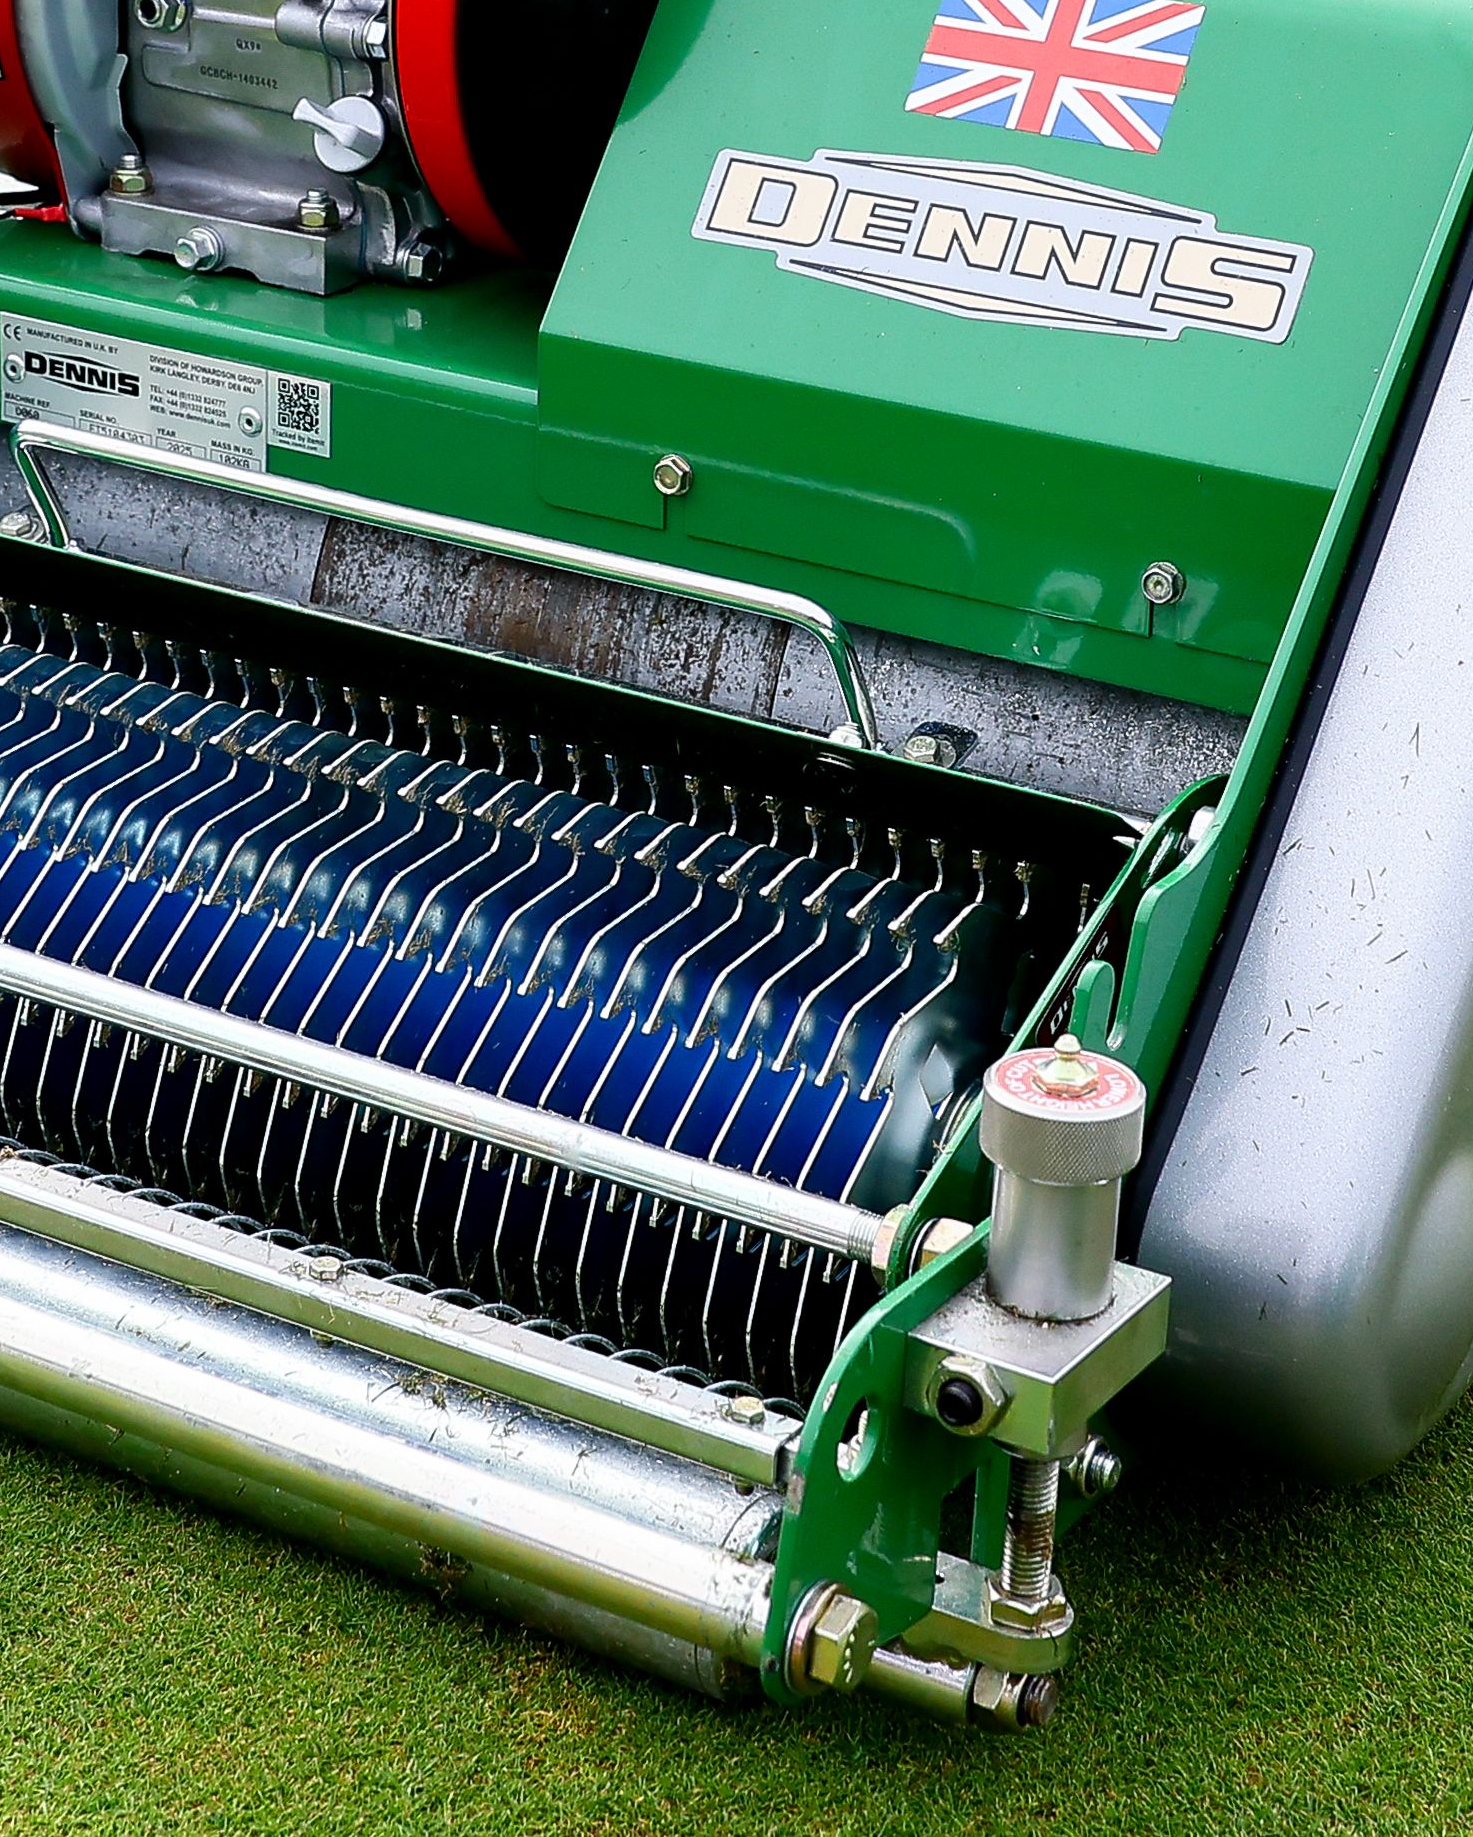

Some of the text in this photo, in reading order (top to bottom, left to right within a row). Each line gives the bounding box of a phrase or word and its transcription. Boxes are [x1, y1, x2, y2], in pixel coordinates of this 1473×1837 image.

[706, 158, 1298, 332] DENNIS
[27, 328, 83, 347] MANUFACTURED
[84, 341, 92, 349] IN
[108, 345, 119, 355] BY
[24, 351, 140, 397] DENNIS
[149, 354, 179, 368] DIVISION
[180, 361, 190, 370] OF
[191, 365, 236, 381] HOWARDSON
[149, 365, 166, 375] KIRK
[4, 392, 36, 406] MACHINE
[149, 384, 164, 394] TEL:
[166, 388, 178, 397] +44
[203, 394, 227, 408] 824777
[149, 394, 164, 404] FAX:
[166, 398, 179, 407] +44
[80, 409, 104, 423] SERIAL
[168, 409, 231, 429] www.dennisuk.com
[156, 428, 176, 438] YEAR
[271, 428, 297, 440] Tracked
[297, 434, 306, 443] by
[211, 440, 232, 451] MASS
[233, 444, 241, 453] IN
[1004, 1059, 1128, 1110] LOWER HEIGHT OF CUT
